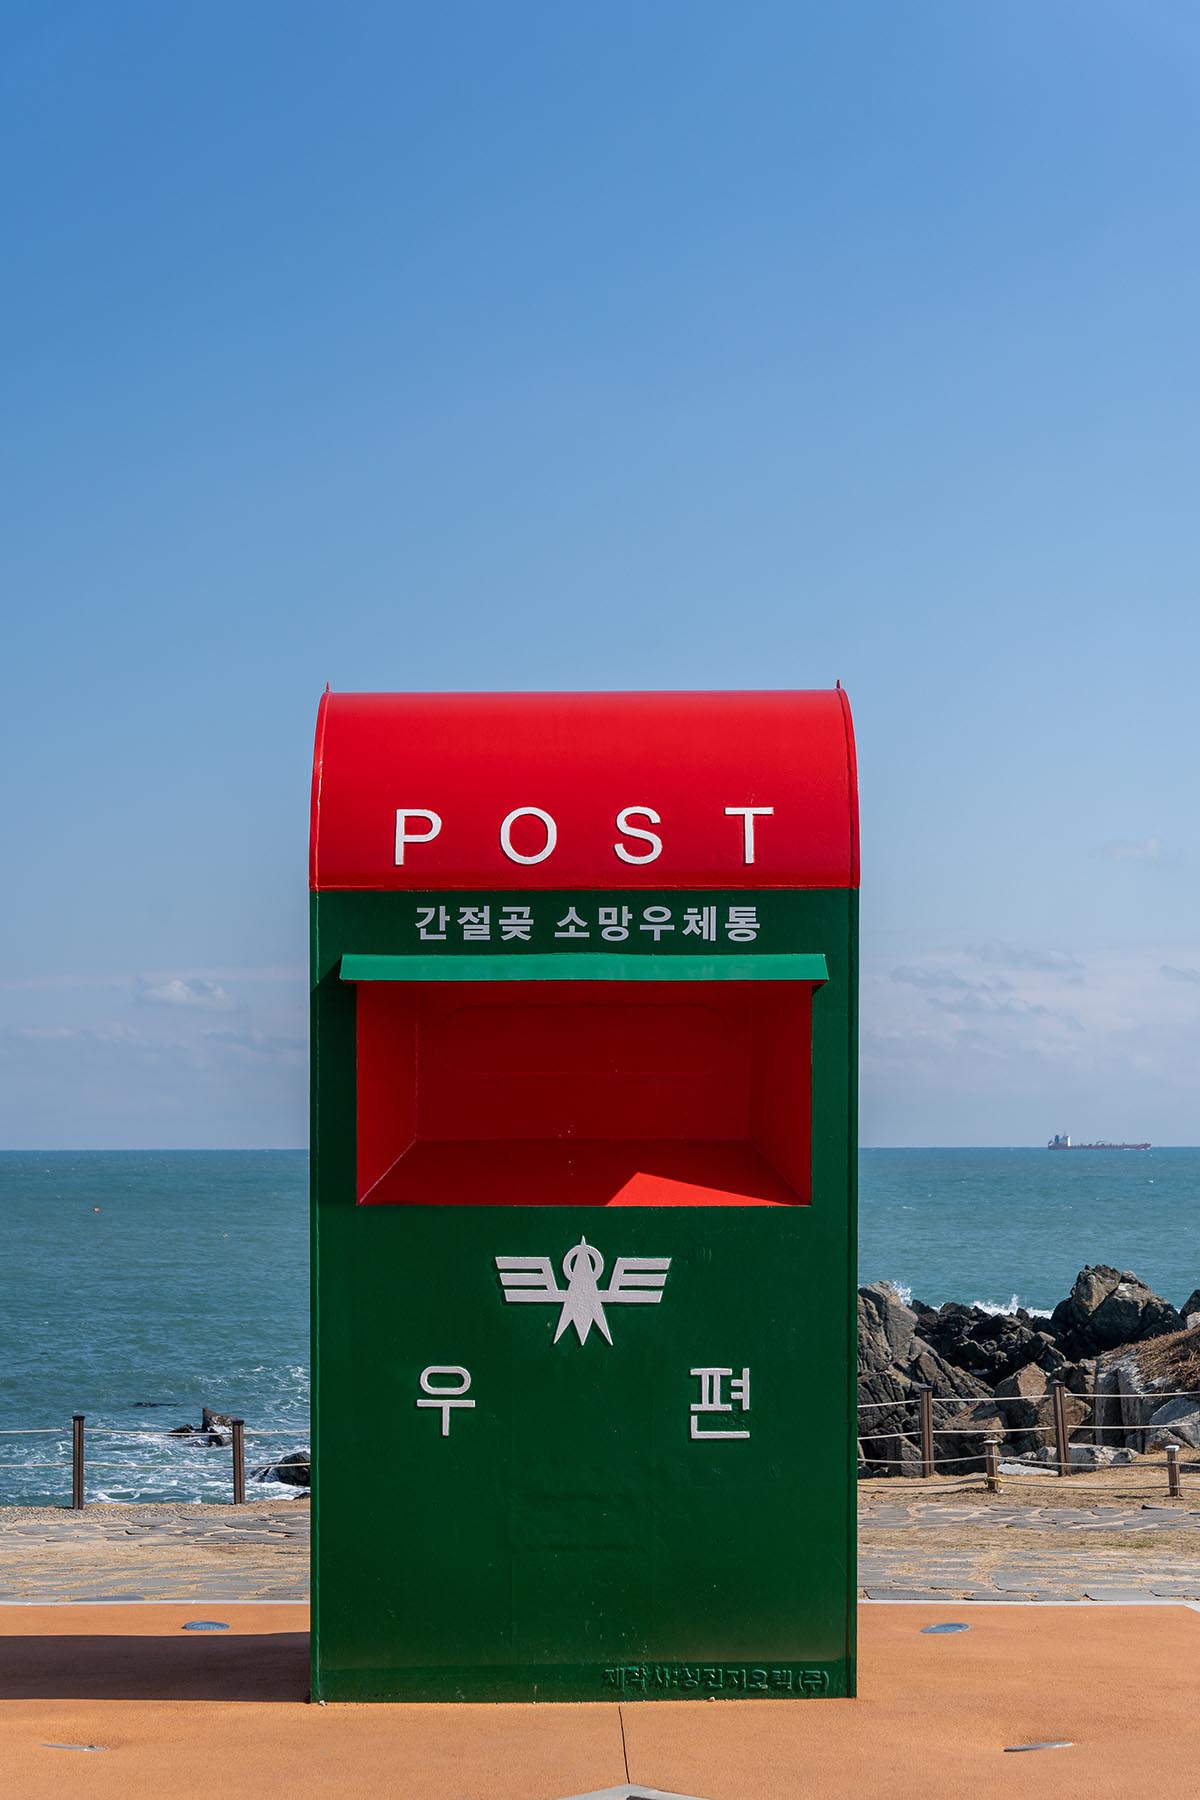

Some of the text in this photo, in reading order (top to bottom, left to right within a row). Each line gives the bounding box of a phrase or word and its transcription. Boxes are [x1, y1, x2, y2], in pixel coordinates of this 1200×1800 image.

[394, 805, 774, 866] POST
[414, 905, 761, 942] 간절곶 소망우체통
